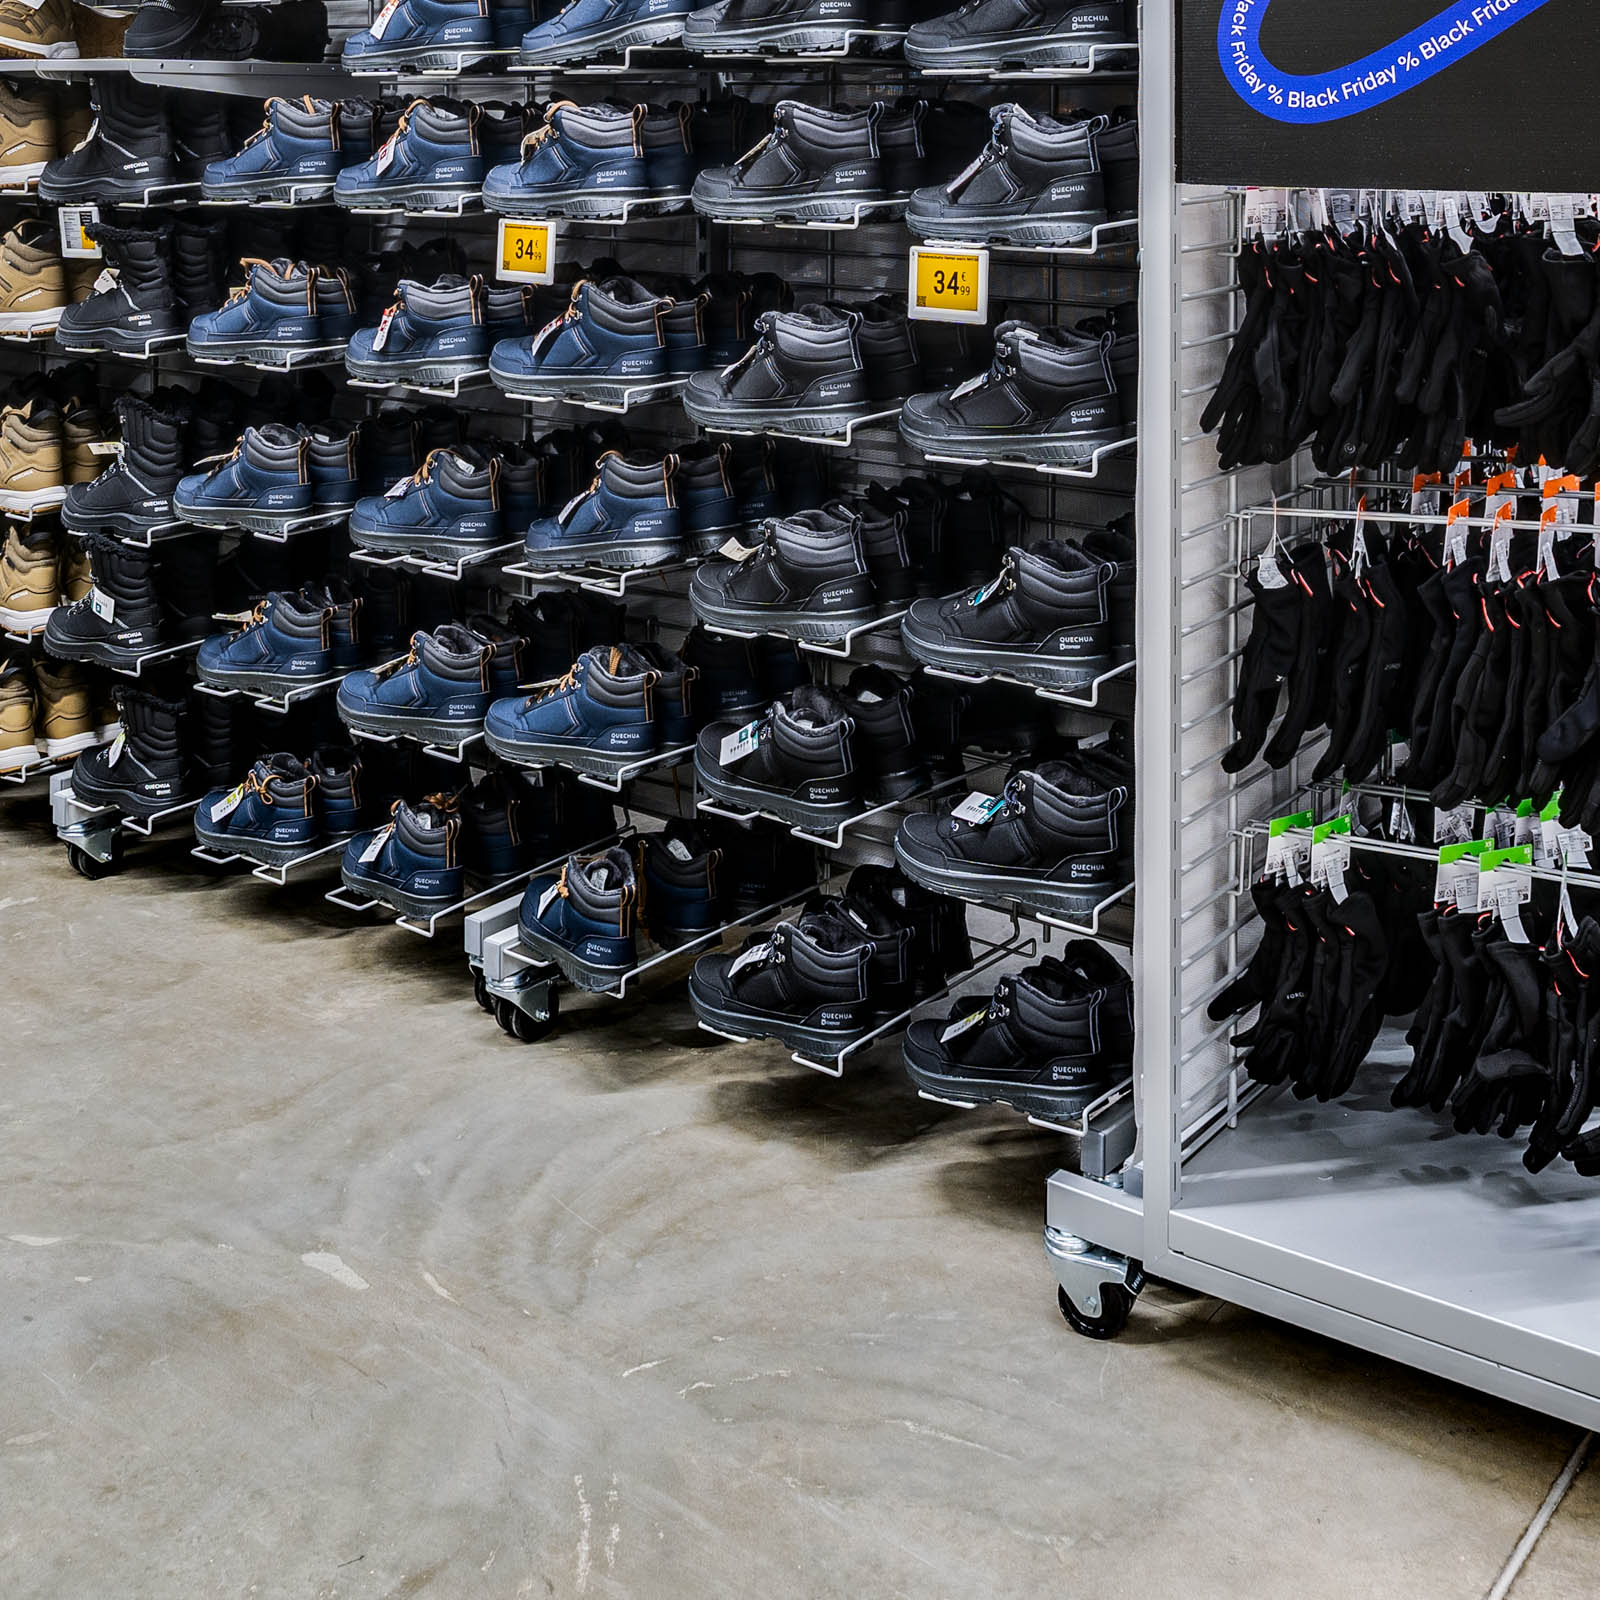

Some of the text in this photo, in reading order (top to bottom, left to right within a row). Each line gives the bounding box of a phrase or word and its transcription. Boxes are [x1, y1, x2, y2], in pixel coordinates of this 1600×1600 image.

[1231, 39, 1266, 93] Friday
[1266, 84, 1284, 104] %
[1287, 88, 1339, 108] Black
[1341, 62, 1398, 99] Friday
[1396, 53, 1420, 71] %
[1420, 18, 1474, 60] Black
[515, 238, 534, 260] 34
[933, 270, 959, 295] 34
[960, 286, 971, 296] 99
[1071, 408, 1104, 416] QUECHUA
[823, 589, 853, 598] QUECHUA
[588, 942, 611, 952] QUECHUA
